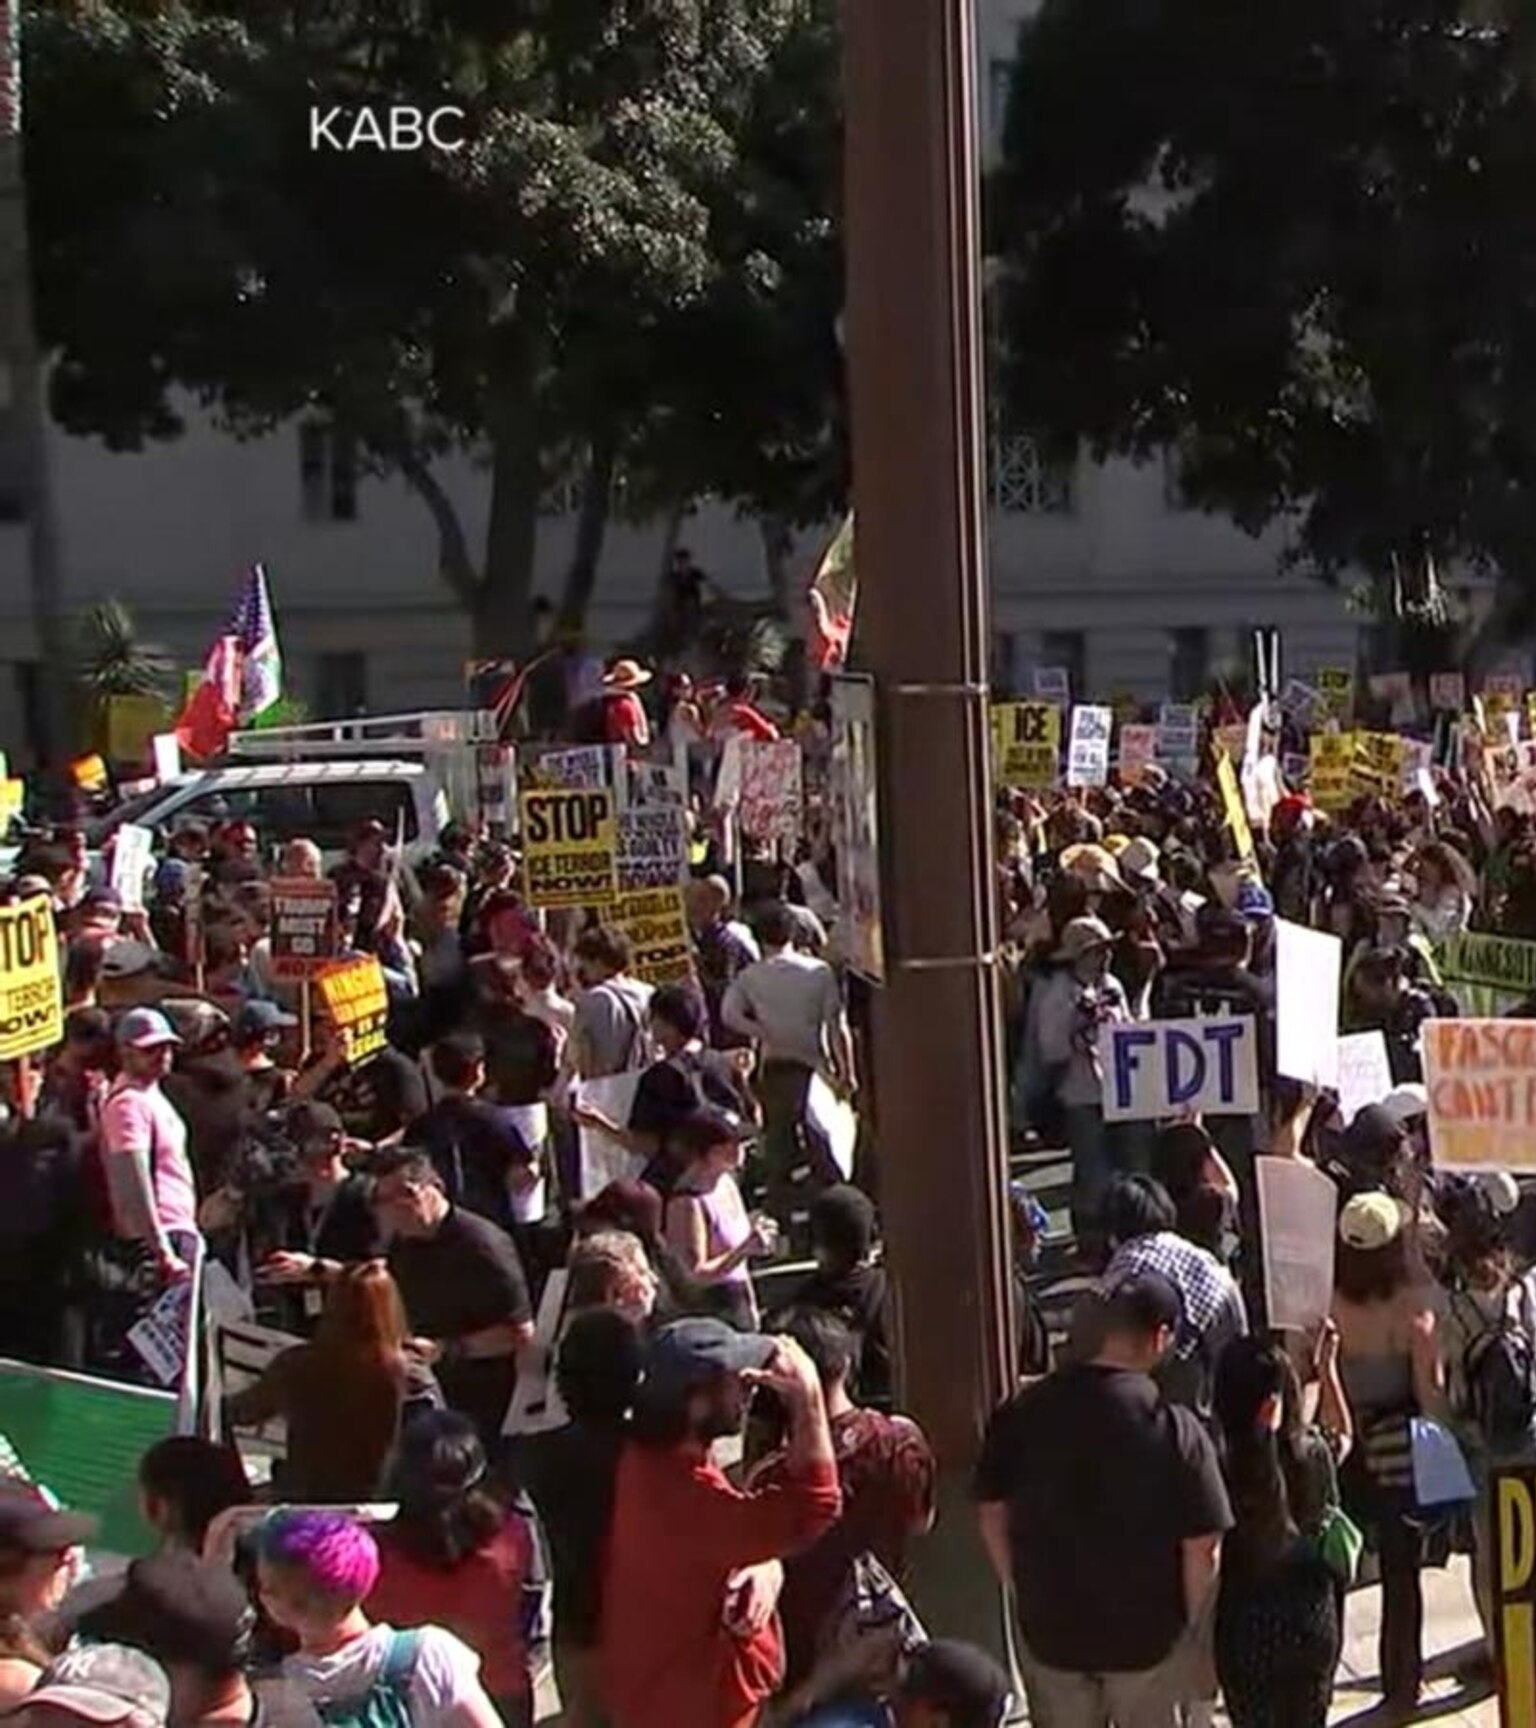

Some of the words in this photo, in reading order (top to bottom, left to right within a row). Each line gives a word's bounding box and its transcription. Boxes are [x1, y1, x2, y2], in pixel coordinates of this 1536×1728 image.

[1014, 706, 1048, 742] ICE
[527, 795, 608, 843] STOP
[553, 851, 612, 875] TERROR
[531, 873, 612, 893] NOW!
[1112, 1022, 1246, 1108] FDT
